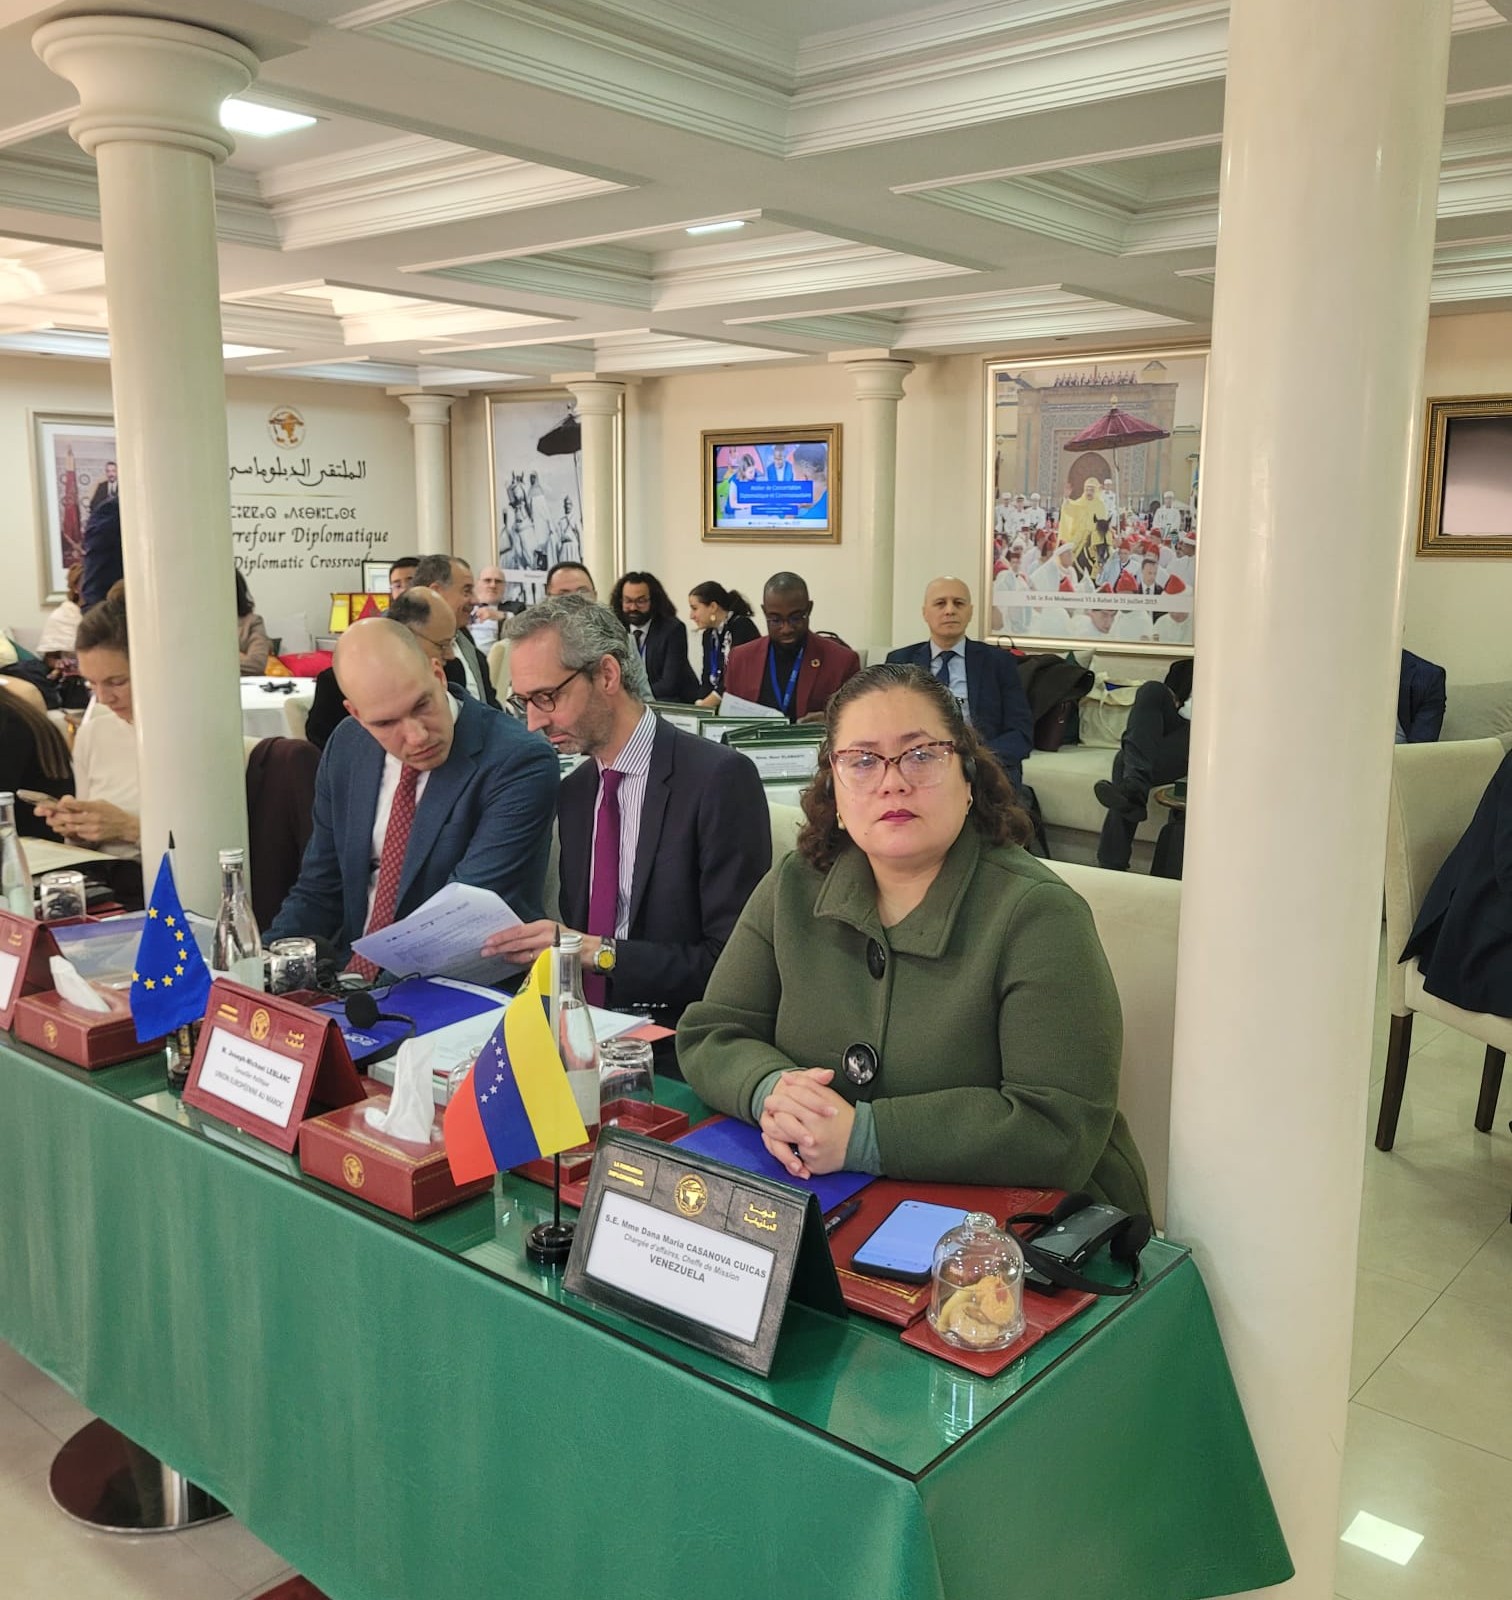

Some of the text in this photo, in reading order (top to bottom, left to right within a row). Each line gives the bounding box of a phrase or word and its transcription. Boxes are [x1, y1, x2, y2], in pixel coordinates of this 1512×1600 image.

[291, 523, 389, 551] Diplomatique
[233, 551, 374, 577] Diplomatic Crossroa
[266, 1066, 291, 1084] LEBLANC
[605, 1214, 767, 1278] S.E. Mme Dana Maria CASANOVA CUICAS
[650, 1253, 705, 1283] VENEZUELA
[682, 1254, 703, 1268] Cheffe
[703, 1263, 712, 1272] de
[714, 1265, 740, 1282] Mission
